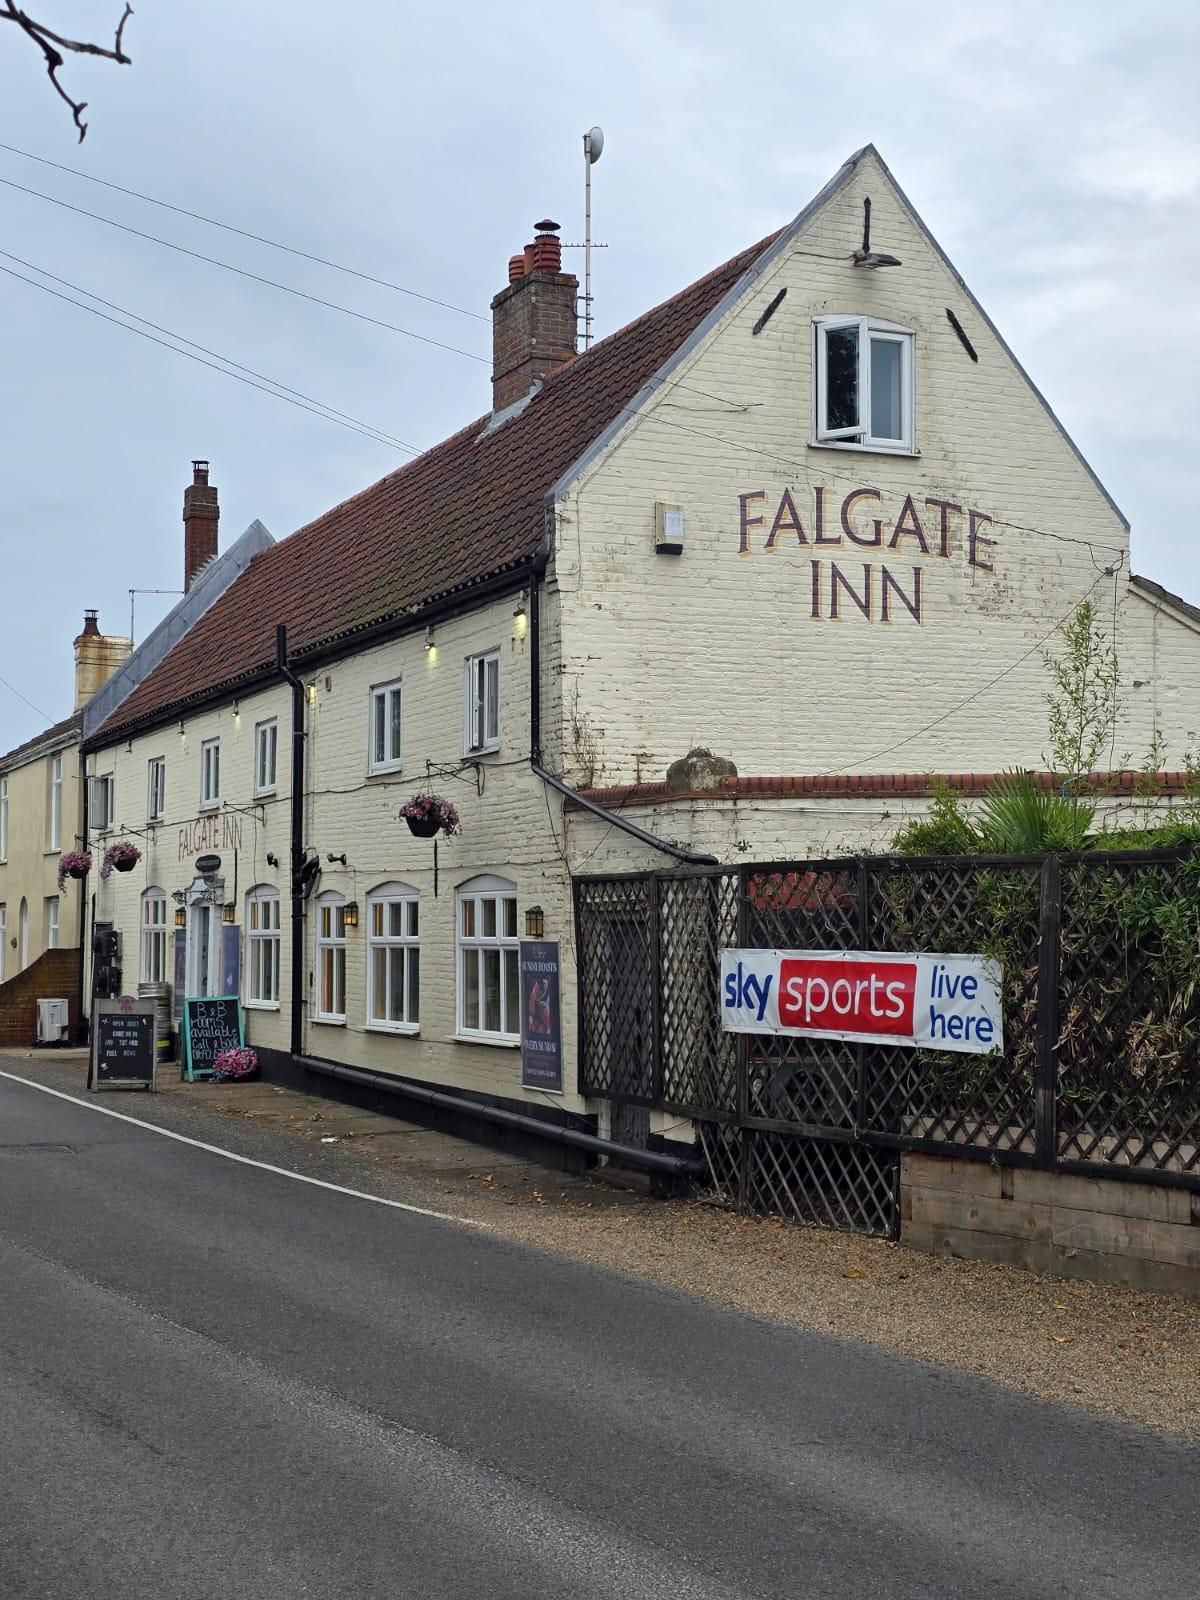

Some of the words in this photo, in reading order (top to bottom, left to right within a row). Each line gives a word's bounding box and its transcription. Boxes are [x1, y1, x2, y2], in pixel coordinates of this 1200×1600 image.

[737, 486, 996, 574] FALGATE
[809, 559, 923, 625] INN
[178, 814, 219, 863] FALGATE
[222, 815, 242, 850] INN
[724, 961, 774, 1022] sky
[785, 973, 906, 1023] sports
[930, 964, 978, 1000] live
[190, 1024, 238, 1039] available
[929, 1004, 994, 1043] here
